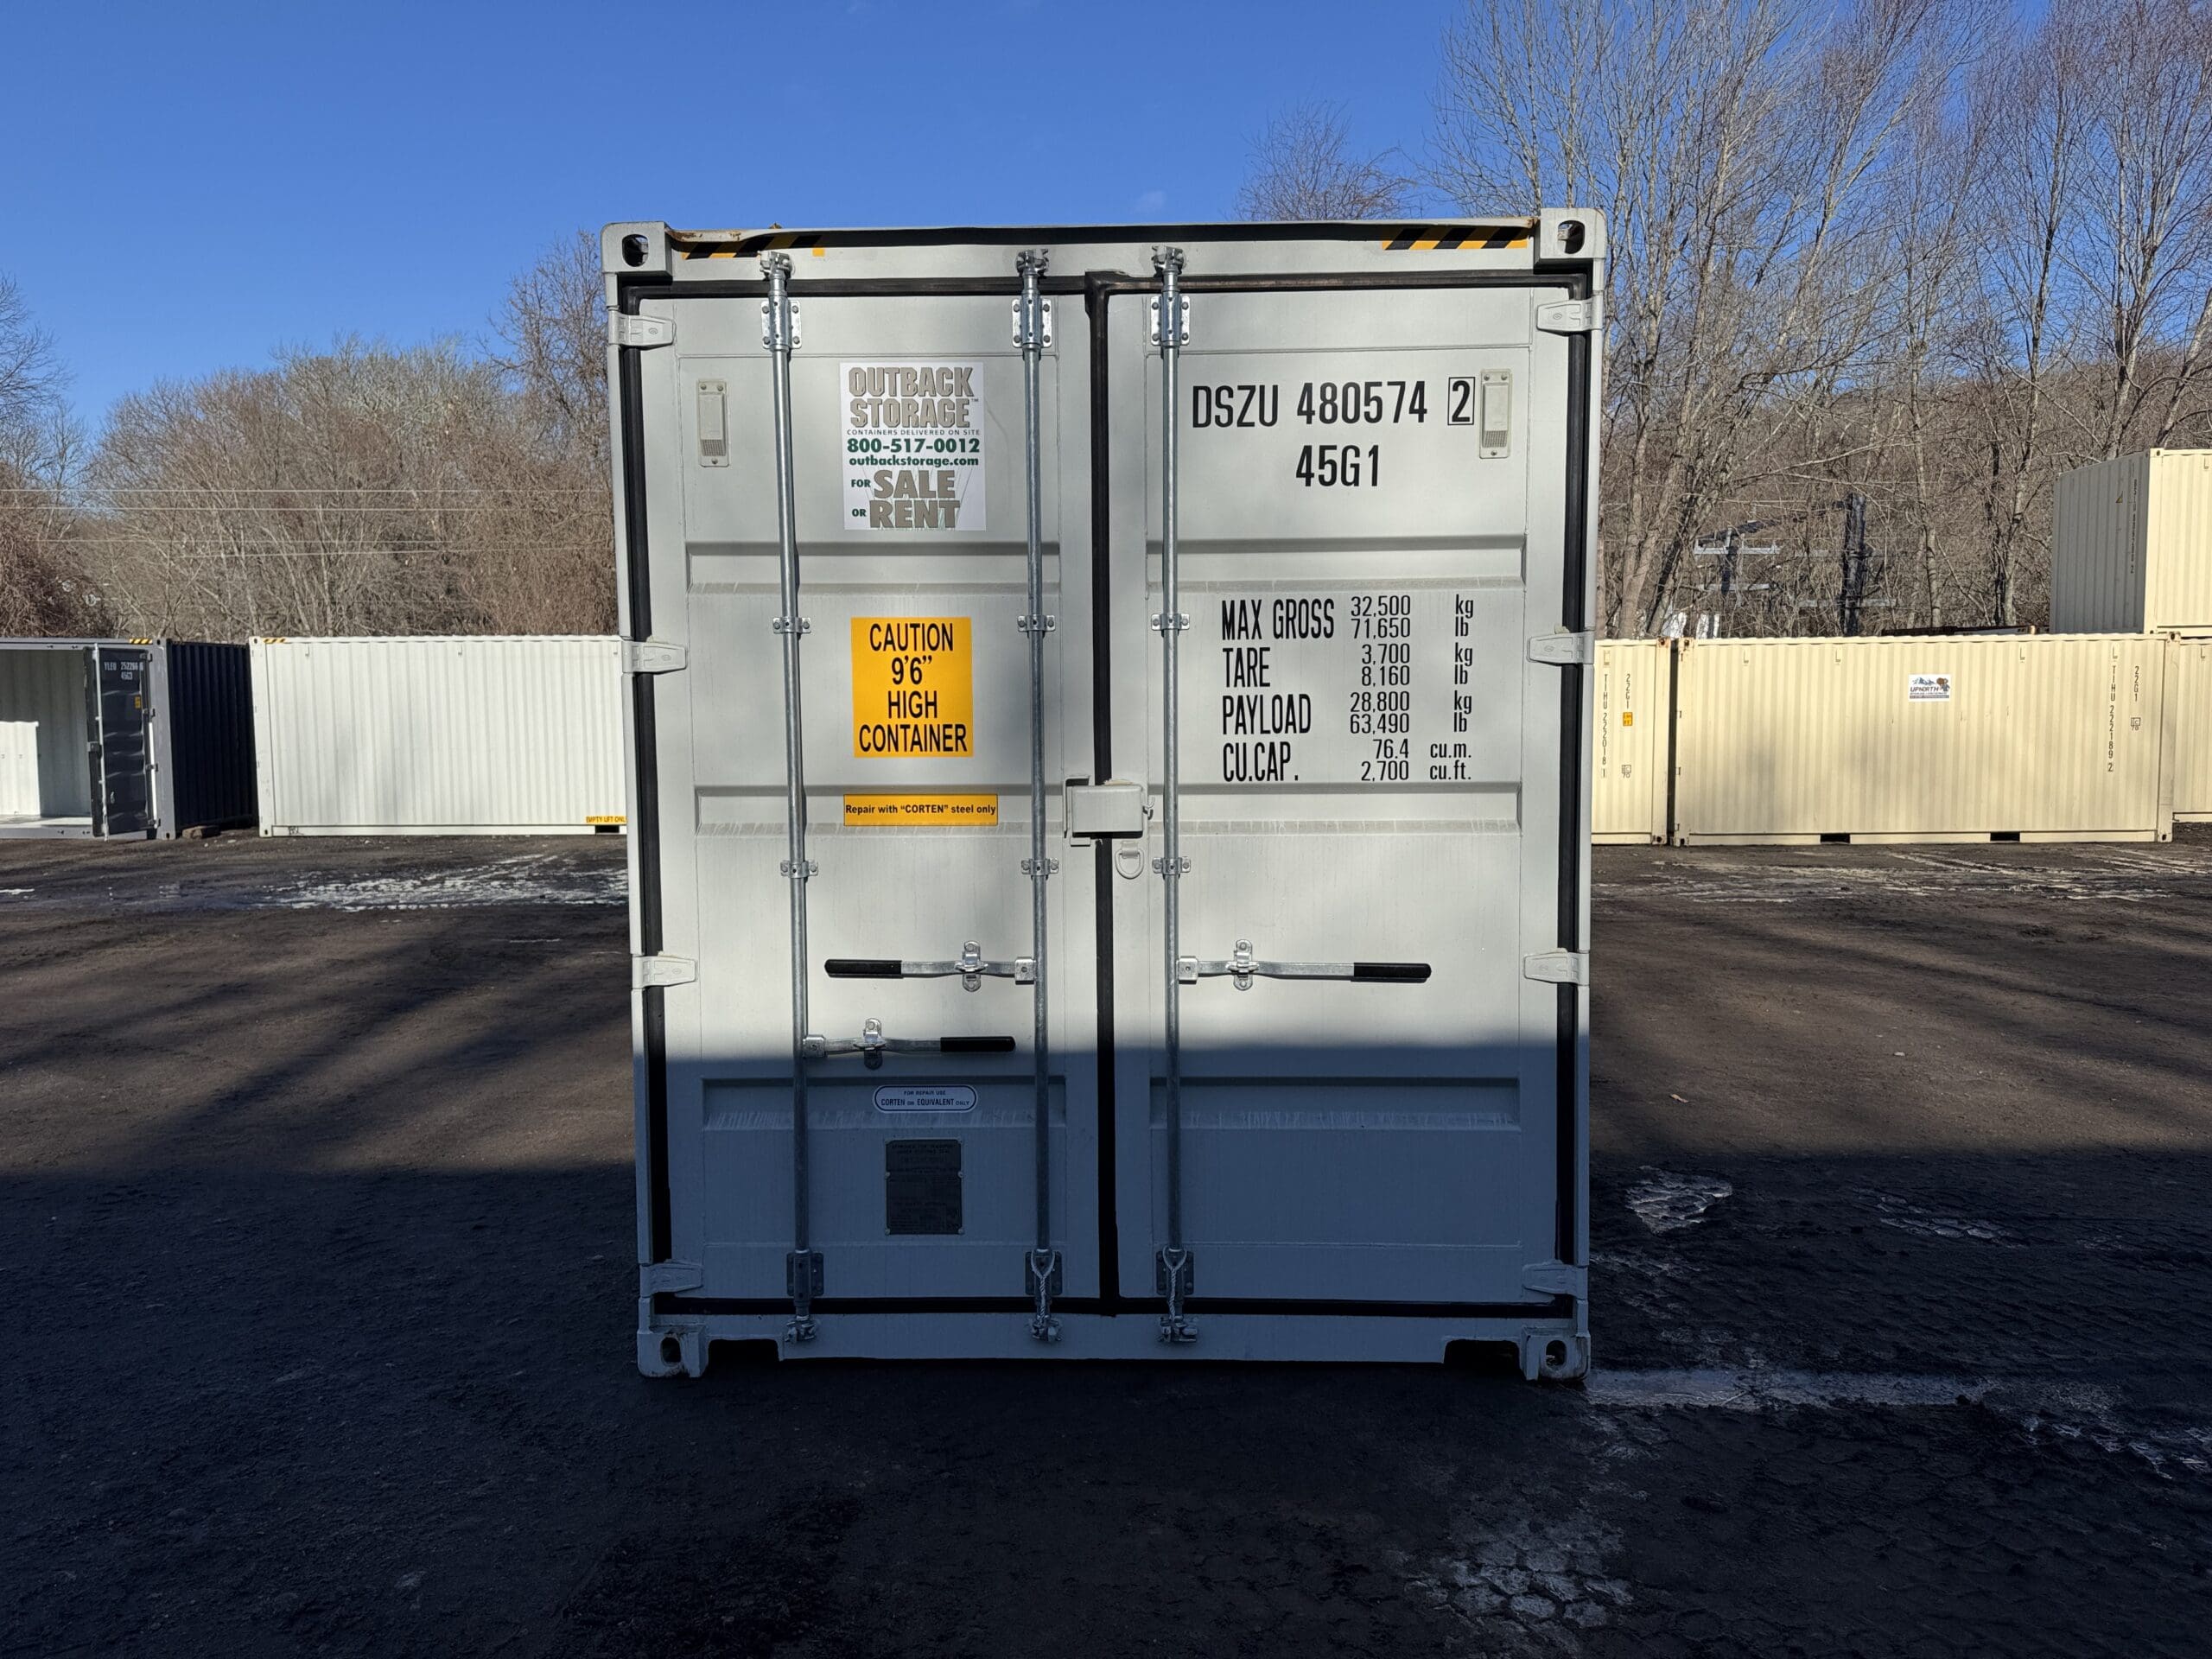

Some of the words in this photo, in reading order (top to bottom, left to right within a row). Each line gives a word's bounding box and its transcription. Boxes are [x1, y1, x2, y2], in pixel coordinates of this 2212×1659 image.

[849, 367, 975, 397] OUTBACK
[849, 398, 970, 428] STORAGE
[1193, 385, 1278, 428] DSZU
[1297, 381, 1427, 424] 480574
[1452, 380, 1470, 422] 2
[847, 438, 980, 453] 800-517-0012
[849, 454, 979, 467] outbackstorage.com
[1296, 445, 1378, 486] 45G1
[851, 479, 871, 488] FOR
[873, 469, 956, 499] SALE
[852, 508, 867, 518] OR
[869, 499, 961, 529] RENT
[1223, 600, 1262, 640] MAX
[1274, 599, 1334, 639] GROSS
[1351, 595, 1410, 617] 32,500
[1456, 594, 1473, 619] kg
[870, 623, 953, 651] CAUTION
[1351, 618, 1410, 639] 71,650
[1456, 617, 1469, 637] lb
[1223, 647, 1270, 687] TARE
[1362, 644, 1409, 664] 3,700
[1455, 642, 1472, 667] kg
[1362, 665, 1409, 686] 8,160
[1455, 664, 1468, 684] lb
[888, 690, 937, 718] HIGH
[1223, 694, 1311, 734] PAYLOAD
[1351, 691, 1409, 712] 28,800
[1454, 690, 1471, 715] kg
[1351, 713, 1409, 734] 63,490
[1454, 712, 1467, 732] lb
[860, 724, 967, 752] CONTAINER
[1373, 739, 1408, 759] 76.4
[1431, 744, 1471, 758] cu.m.
[1224, 741, 1298, 782] CU.CAP.
[1362, 760, 1408, 781] 2,700
[1430, 760, 1471, 779] cu.ft.
[2108, 763, 2113, 772] 2
[845, 805, 875, 816] Repair
[976, 805, 996, 816] only
